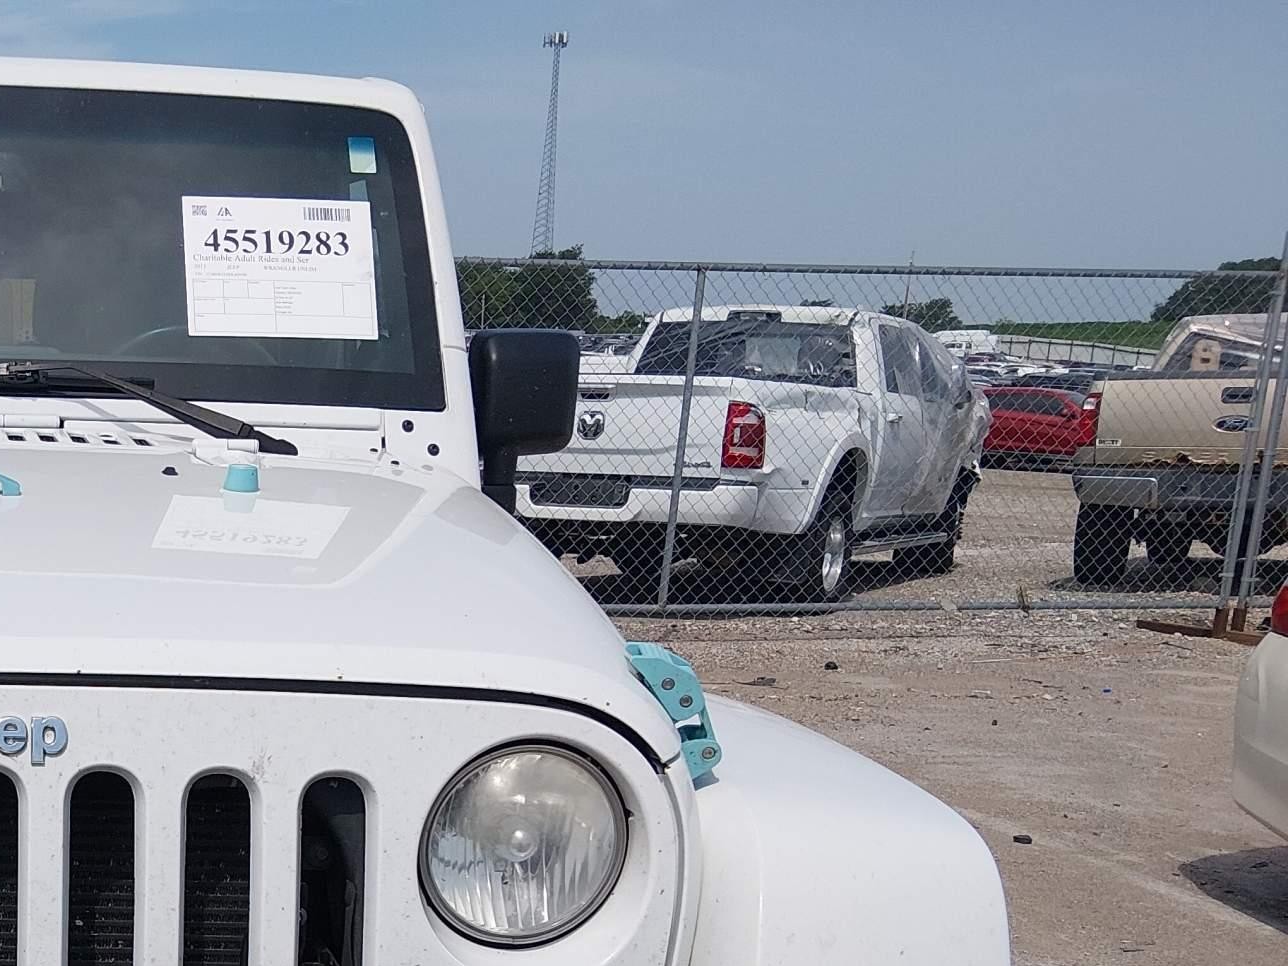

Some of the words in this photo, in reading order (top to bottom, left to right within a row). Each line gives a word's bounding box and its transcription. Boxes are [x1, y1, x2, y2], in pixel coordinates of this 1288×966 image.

[204, 228, 350, 256] 45519283
[192, 253, 233, 263] Charitable
[234, 254, 256, 263] Adult
[258, 255, 279, 264] Rides
[280, 255, 295, 264] and
